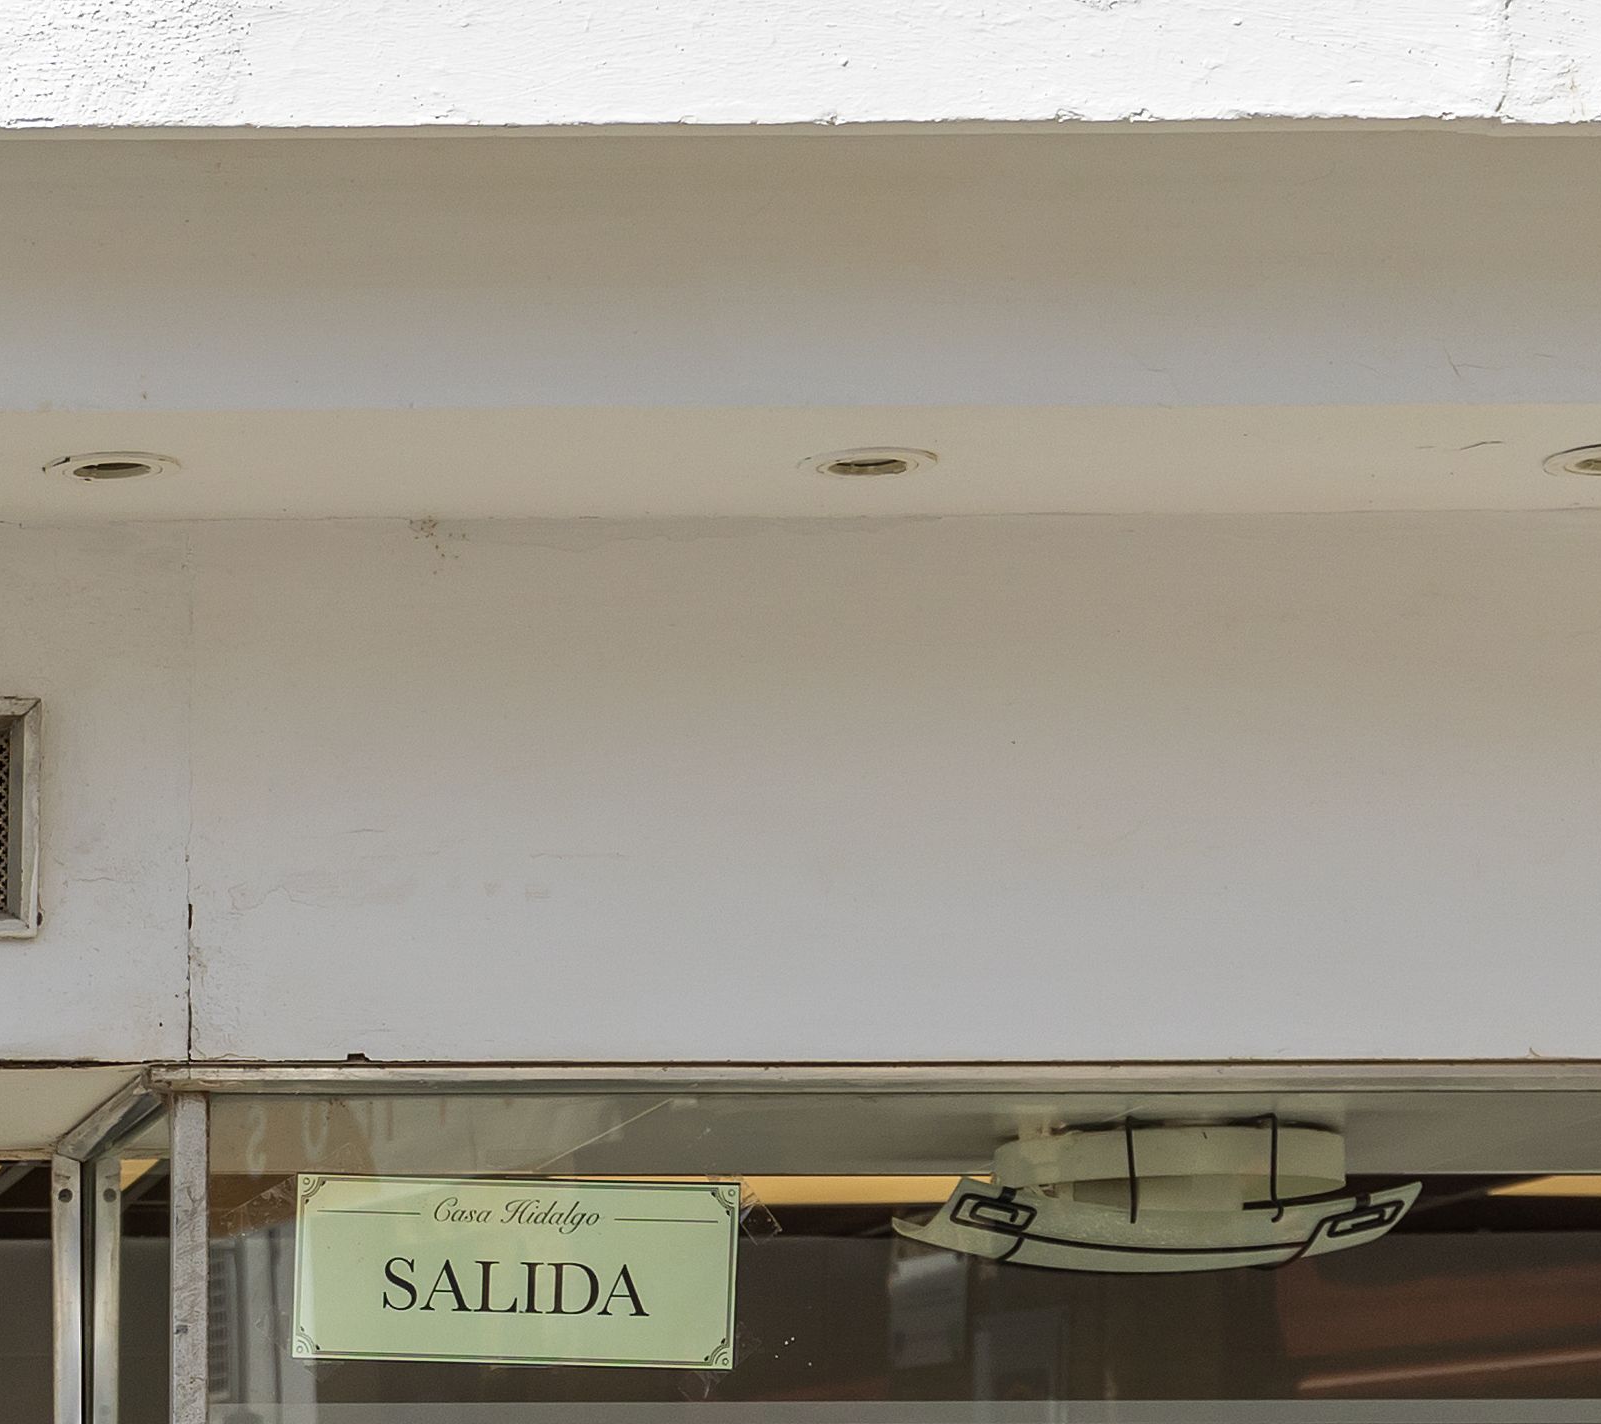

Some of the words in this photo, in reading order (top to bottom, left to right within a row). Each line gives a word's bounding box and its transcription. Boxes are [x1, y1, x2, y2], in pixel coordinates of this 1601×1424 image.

[433, 1197, 493, 1225] Casa
[501, 1199, 601, 1235] Hidalgo
[382, 1256, 650, 1317] SALIDA
